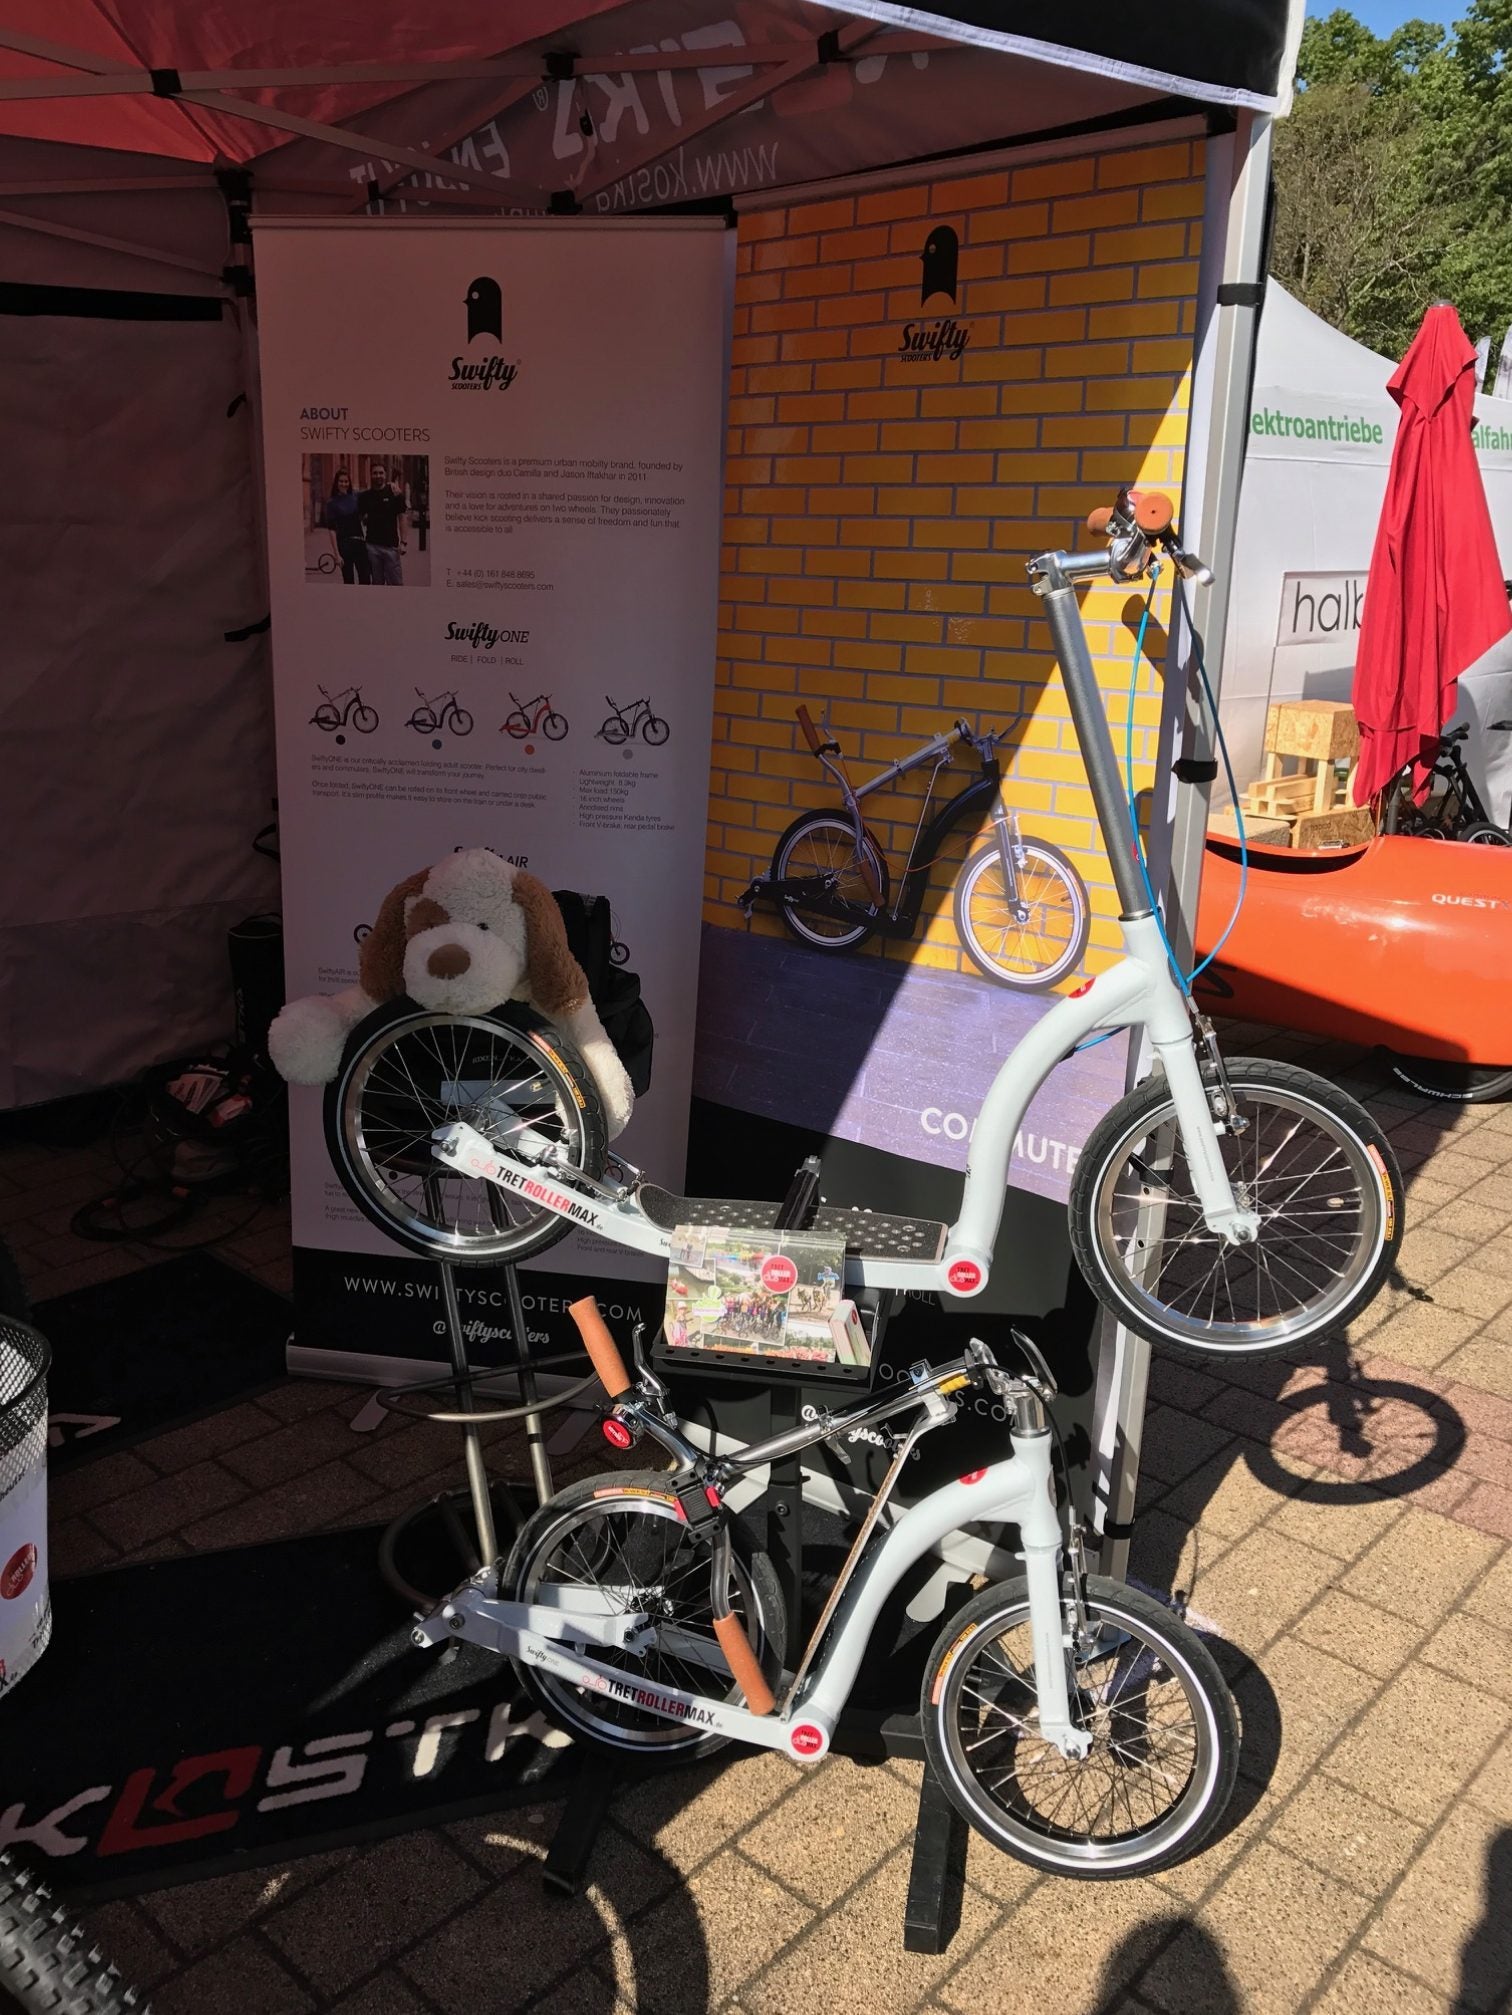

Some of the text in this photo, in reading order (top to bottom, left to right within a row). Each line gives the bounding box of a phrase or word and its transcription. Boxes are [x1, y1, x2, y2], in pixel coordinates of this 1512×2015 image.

[898, 320, 970, 361] Swifty
[448, 356, 518, 391] Swifty
[300, 407, 348, 421] ABOUT
[300, 426, 431, 443] SWIFTY SCOOTERS
[1252, 407, 1512, 450] ektroantriebe alfah
[444, 456, 466, 466] Swifty
[469, 457, 501, 466] Scooters
[503, 458, 510, 466] is
[518, 459, 551, 468] premium
[553, 459, 577, 468] urban
[580, 459, 608, 470] mobility
[638, 461, 671, 471] founded
[673, 462, 684, 472] by
[445, 489, 464, 499] Their
[465, 491, 487, 500] vision
[489, 491, 496, 500] is
[497, 491, 521, 500] rooted
[522, 492, 530, 501] in
[538, 492, 566, 501] shared
[567, 493, 599, 503] passion
[600, 493, 611, 502] for
[644, 496, 685, 505] innovation
[445, 502, 461, 511] and
[469, 502, 485, 511] love
[486, 502, 496, 511] for
[498, 503, 539, 512] adventures
[540, 504, 551, 512] on
[552, 504, 566, 513] two
[600, 506, 619, 517] They
[621, 507, 671, 518] passionately
[445, 512, 680, 529] believe kick scooting delivers a sense of freedom and fun that
[451, 654, 525, 666] RIDE FOLD ROLL
[1431, 893, 1500, 910] QUEST
[920, 1107, 1084, 1176] COUTE
